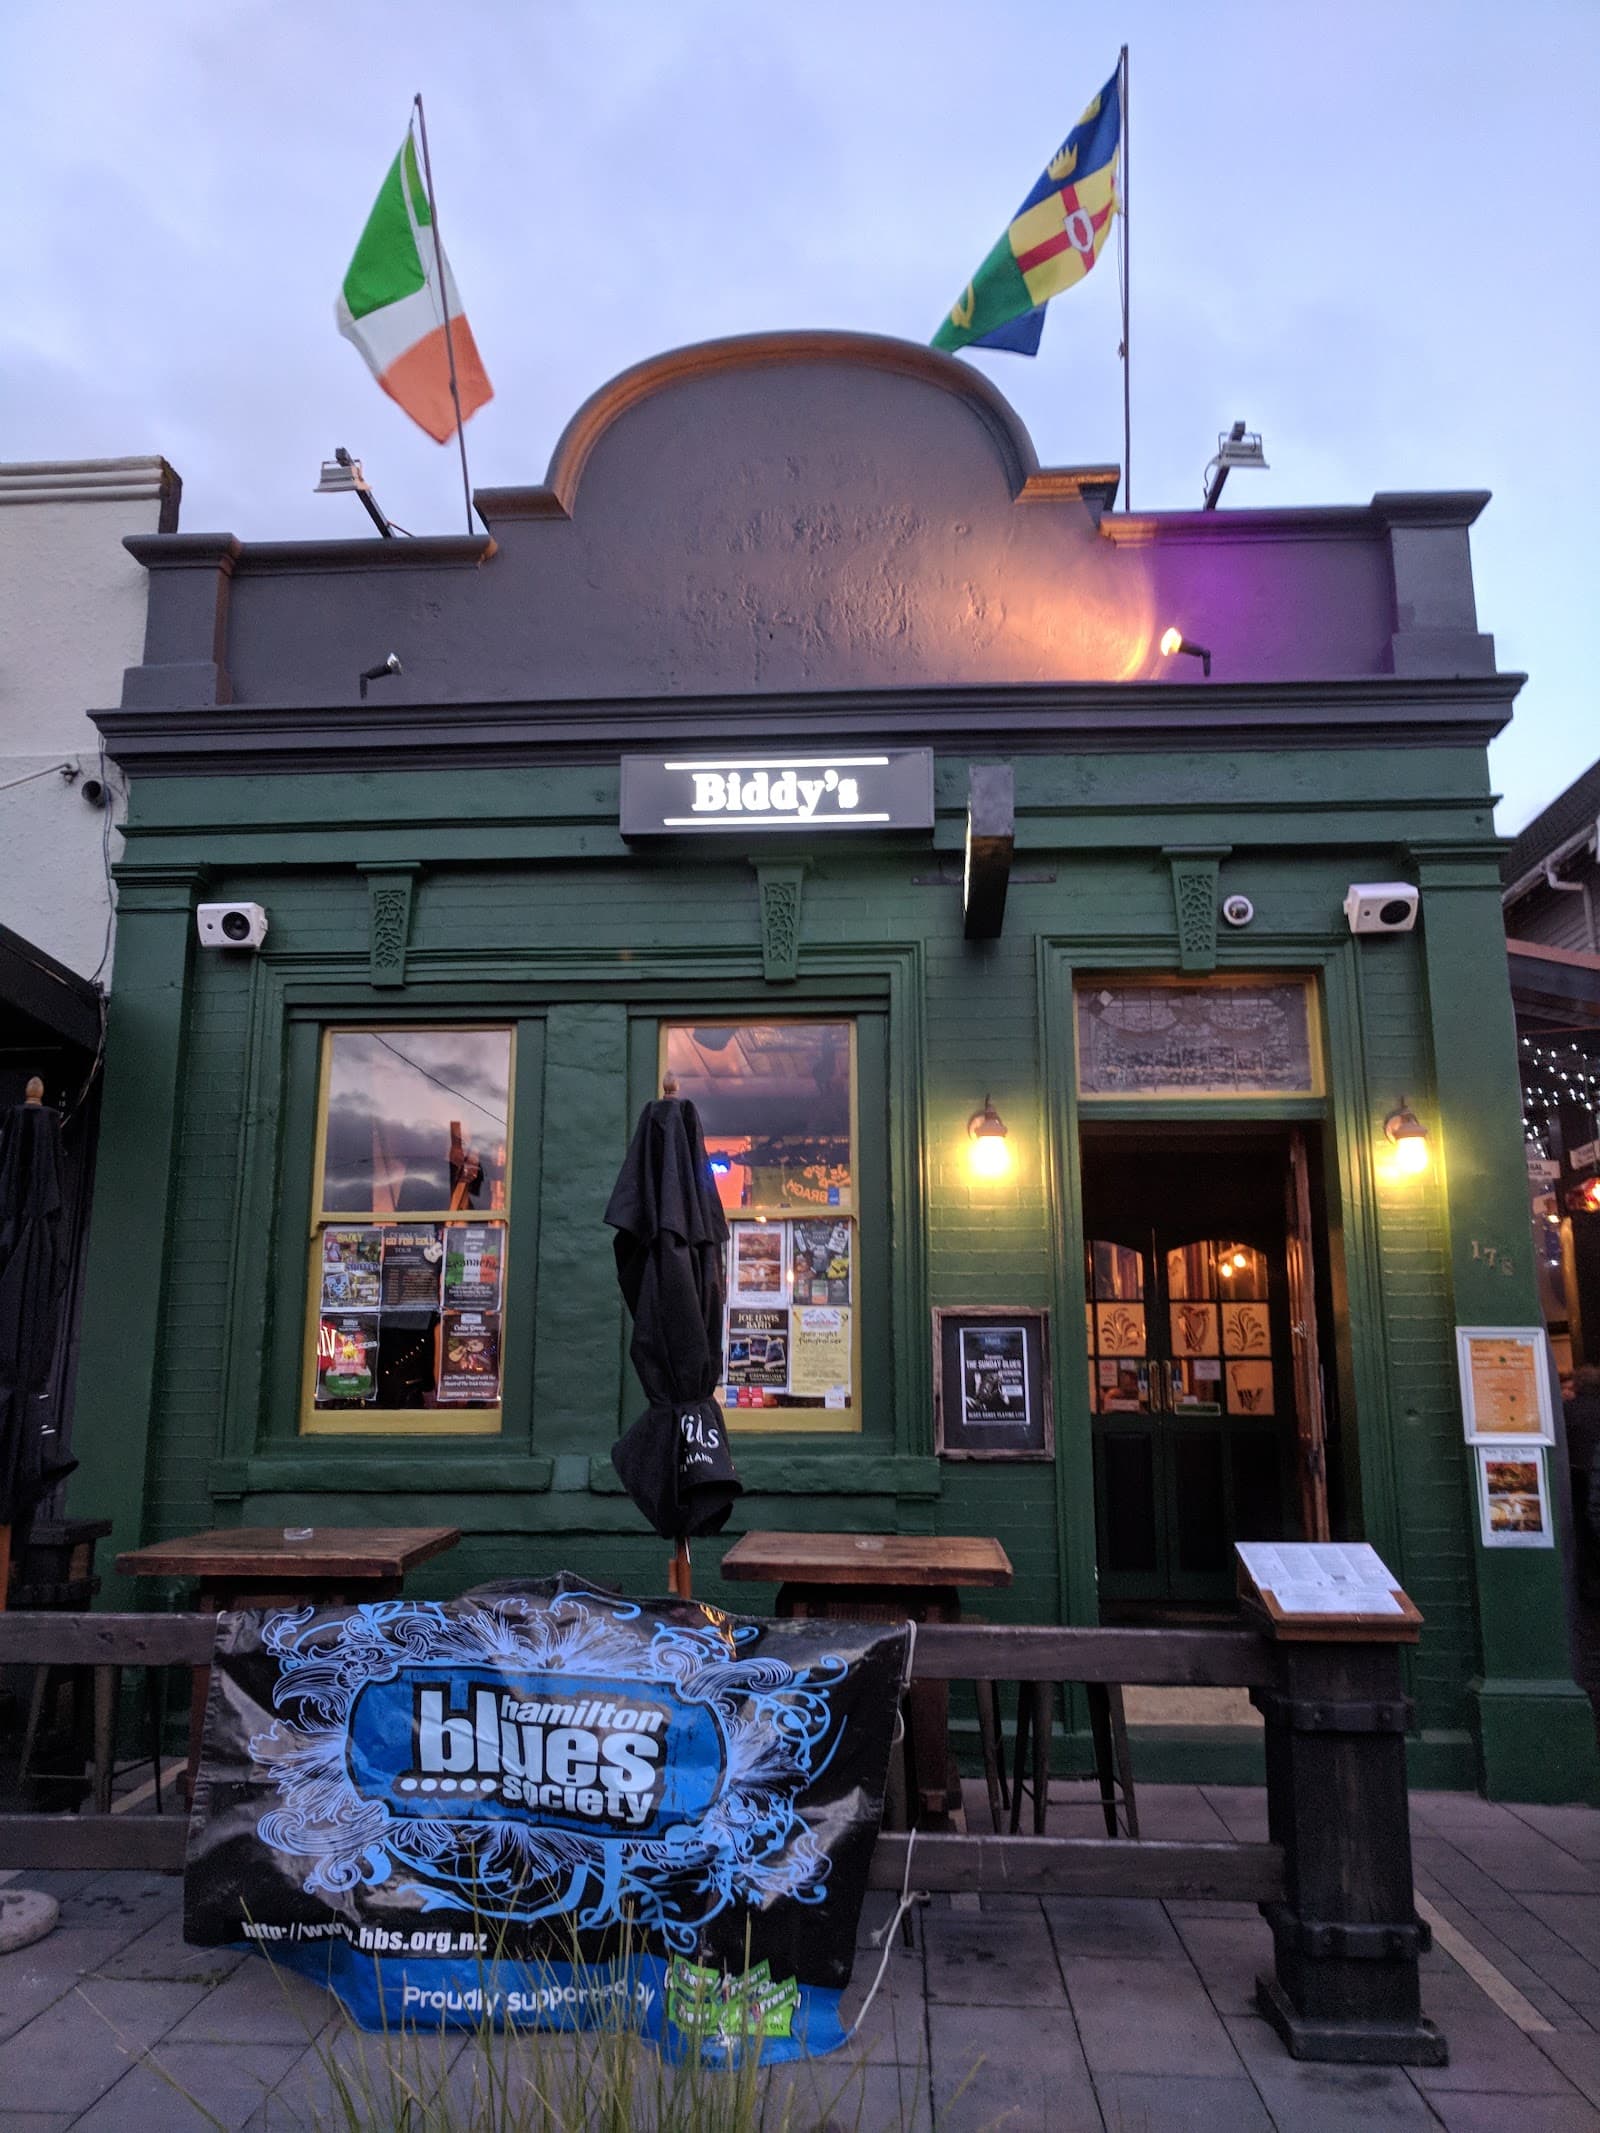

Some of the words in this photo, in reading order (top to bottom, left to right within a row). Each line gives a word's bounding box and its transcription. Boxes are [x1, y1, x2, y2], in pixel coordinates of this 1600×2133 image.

[691, 769, 859, 817] Biddy's
[501, 1695, 663, 1732] hamilton
[419, 1690, 660, 1793] blues
[502, 1775, 654, 1824] society
[404, 1985, 499, 2016] Proudly
